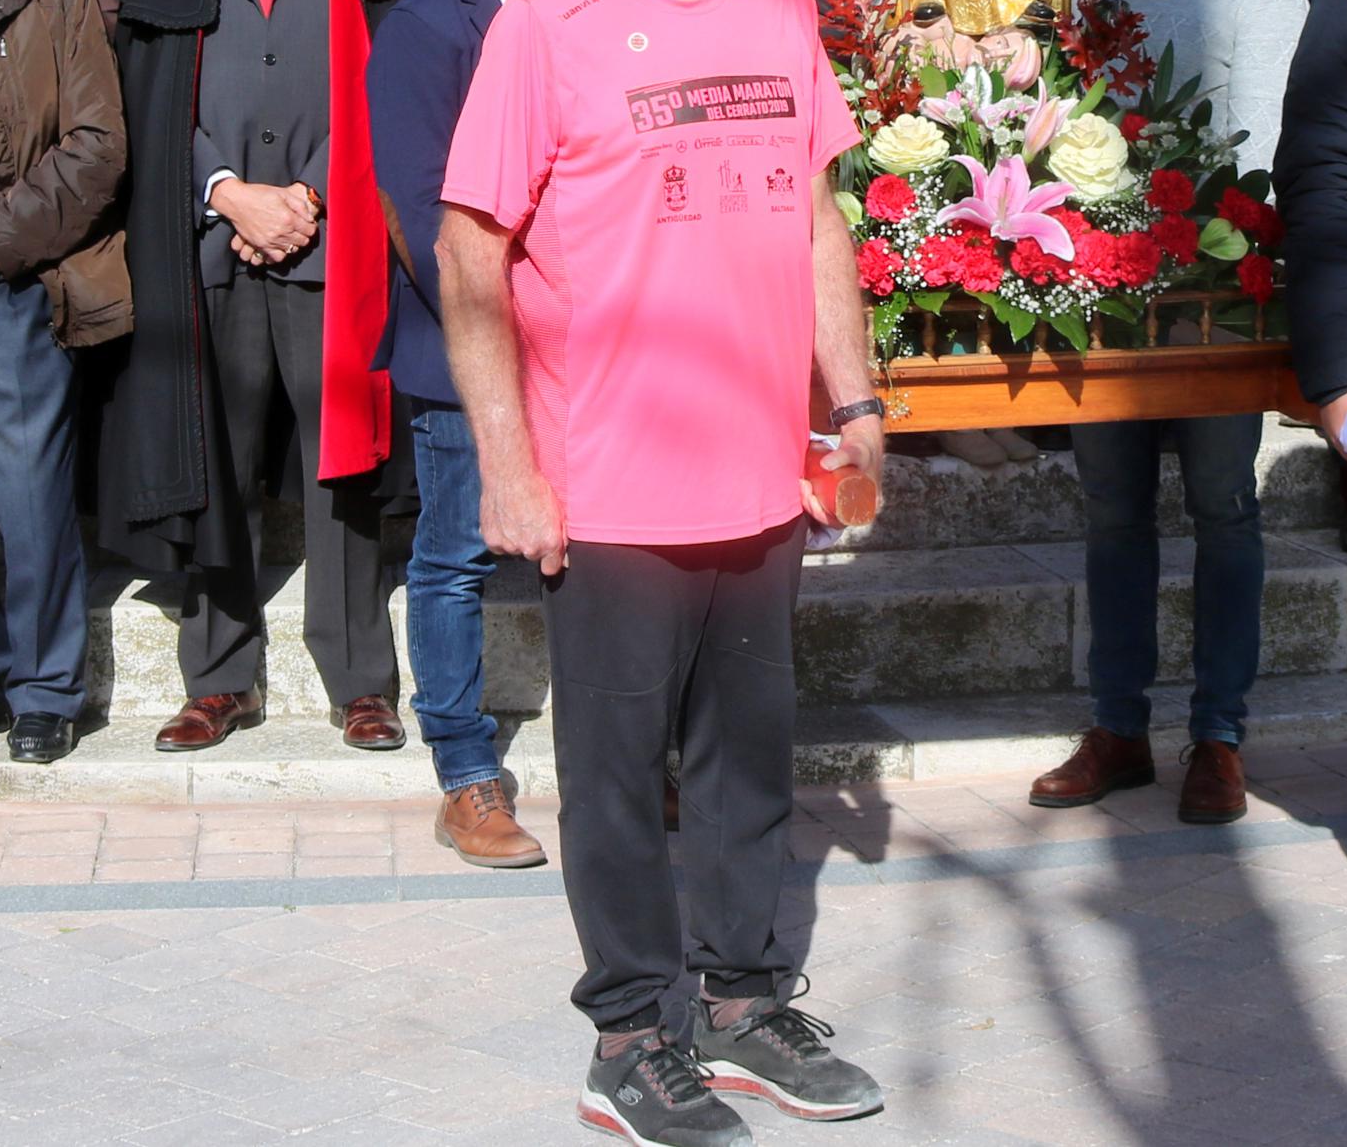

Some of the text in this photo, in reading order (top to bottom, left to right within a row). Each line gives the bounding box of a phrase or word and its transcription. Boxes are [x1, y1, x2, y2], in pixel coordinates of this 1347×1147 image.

[685, 84, 732, 108] MEDIA
[731, 78, 793, 101] MARATÓN
[706, 99, 790, 121] DEL CERRATO 2019
[656, 213, 703, 225] ANTIGÜEDAD
